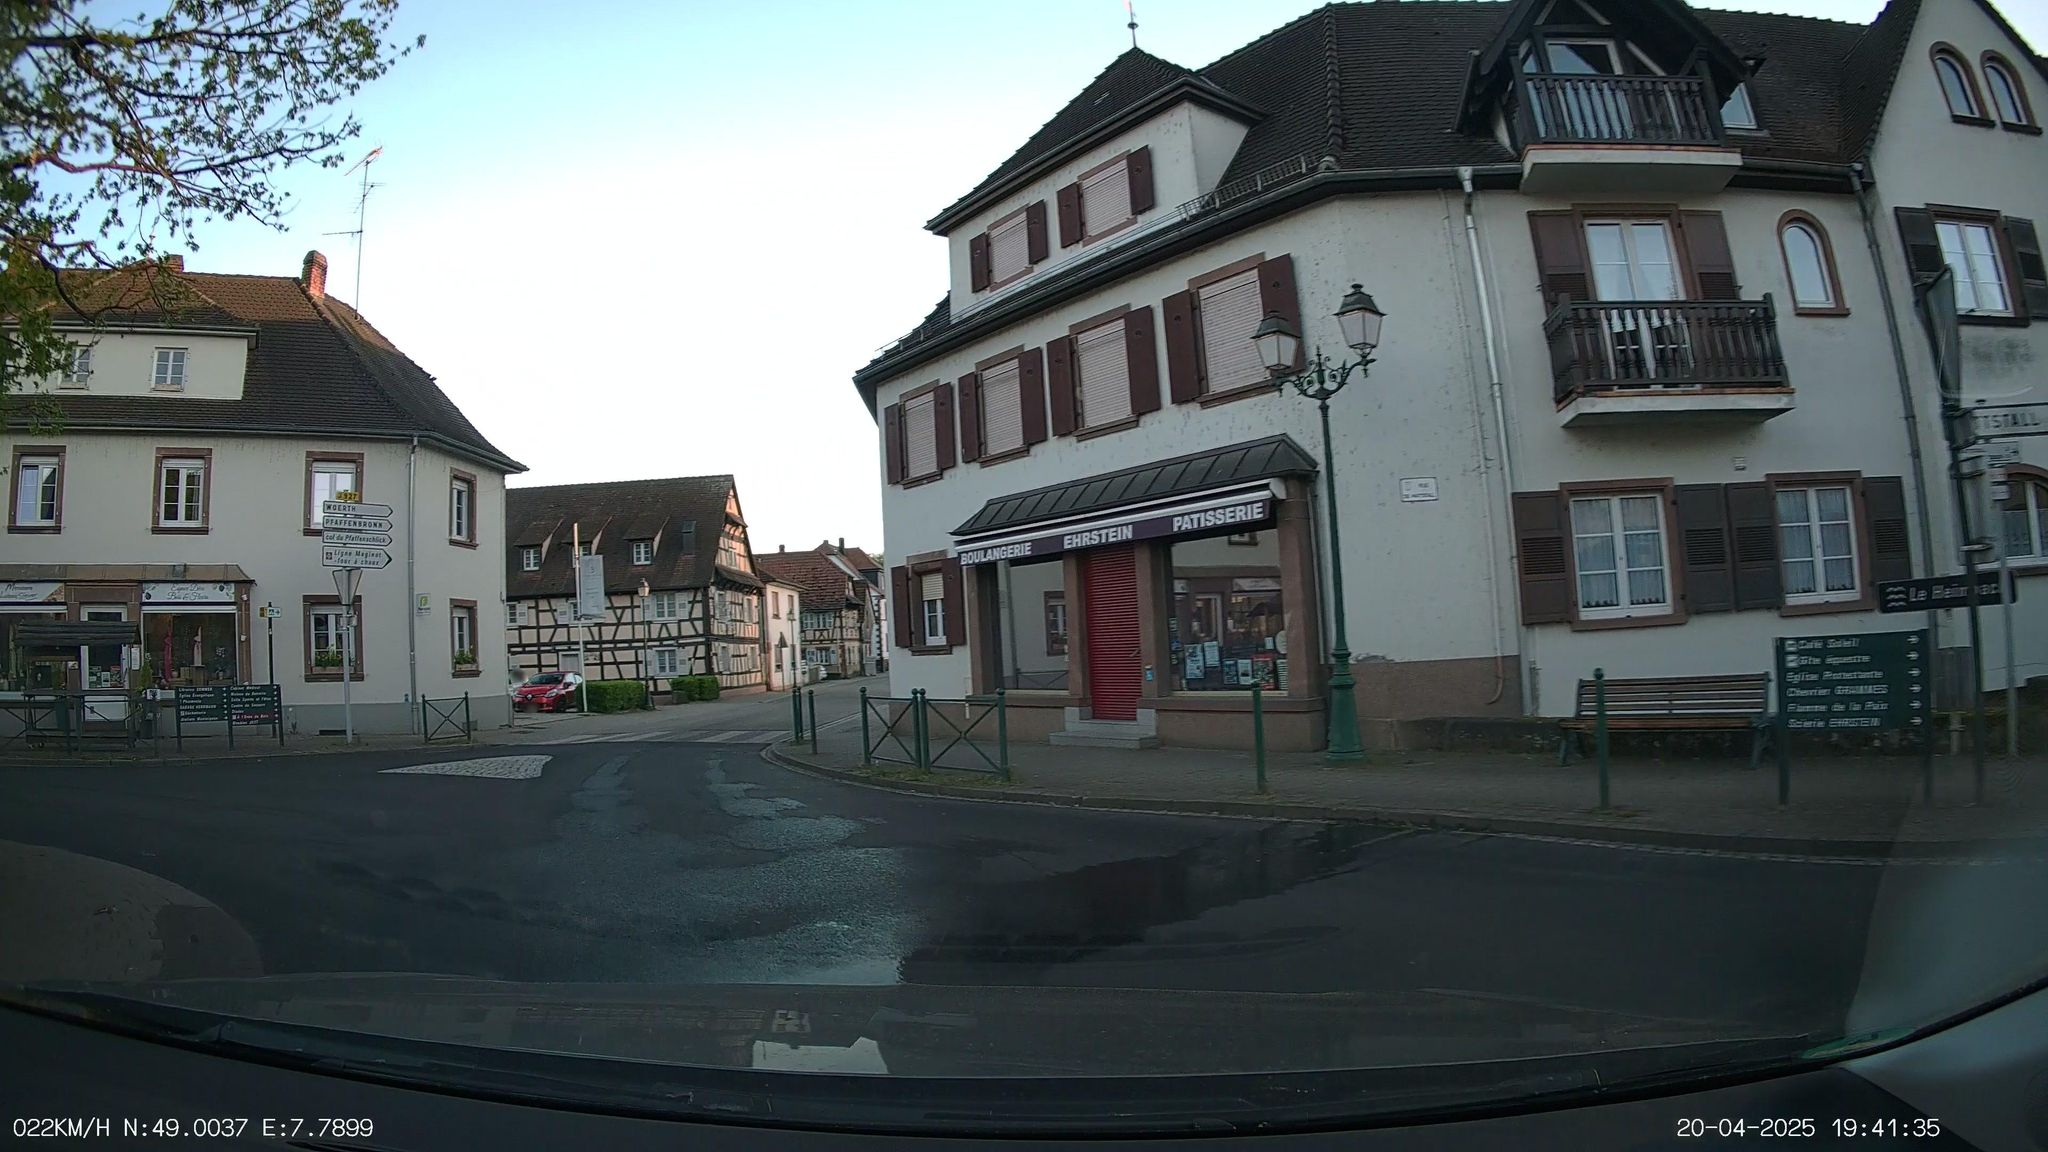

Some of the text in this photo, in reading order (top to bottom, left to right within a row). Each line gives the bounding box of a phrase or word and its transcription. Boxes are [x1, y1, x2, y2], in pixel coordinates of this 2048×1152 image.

[344, 492, 358, 500] 927
[326, 504, 356, 512] WOERTH
[325, 518, 383, 528] PFAFFENBRONN
[960, 502, 1264, 566] BOULANGERIE EHRSTEIN PATISSERIE
[334, 550, 382, 559] Ligne Maginot
[1909, 583, 2000, 602] Le Heimac
[1798, 638, 1860, 649] Café Soleil
[1822, 671, 1883, 680] Protestante
[1831, 703, 1846, 711] de
[1848, 702, 1861, 711] la
